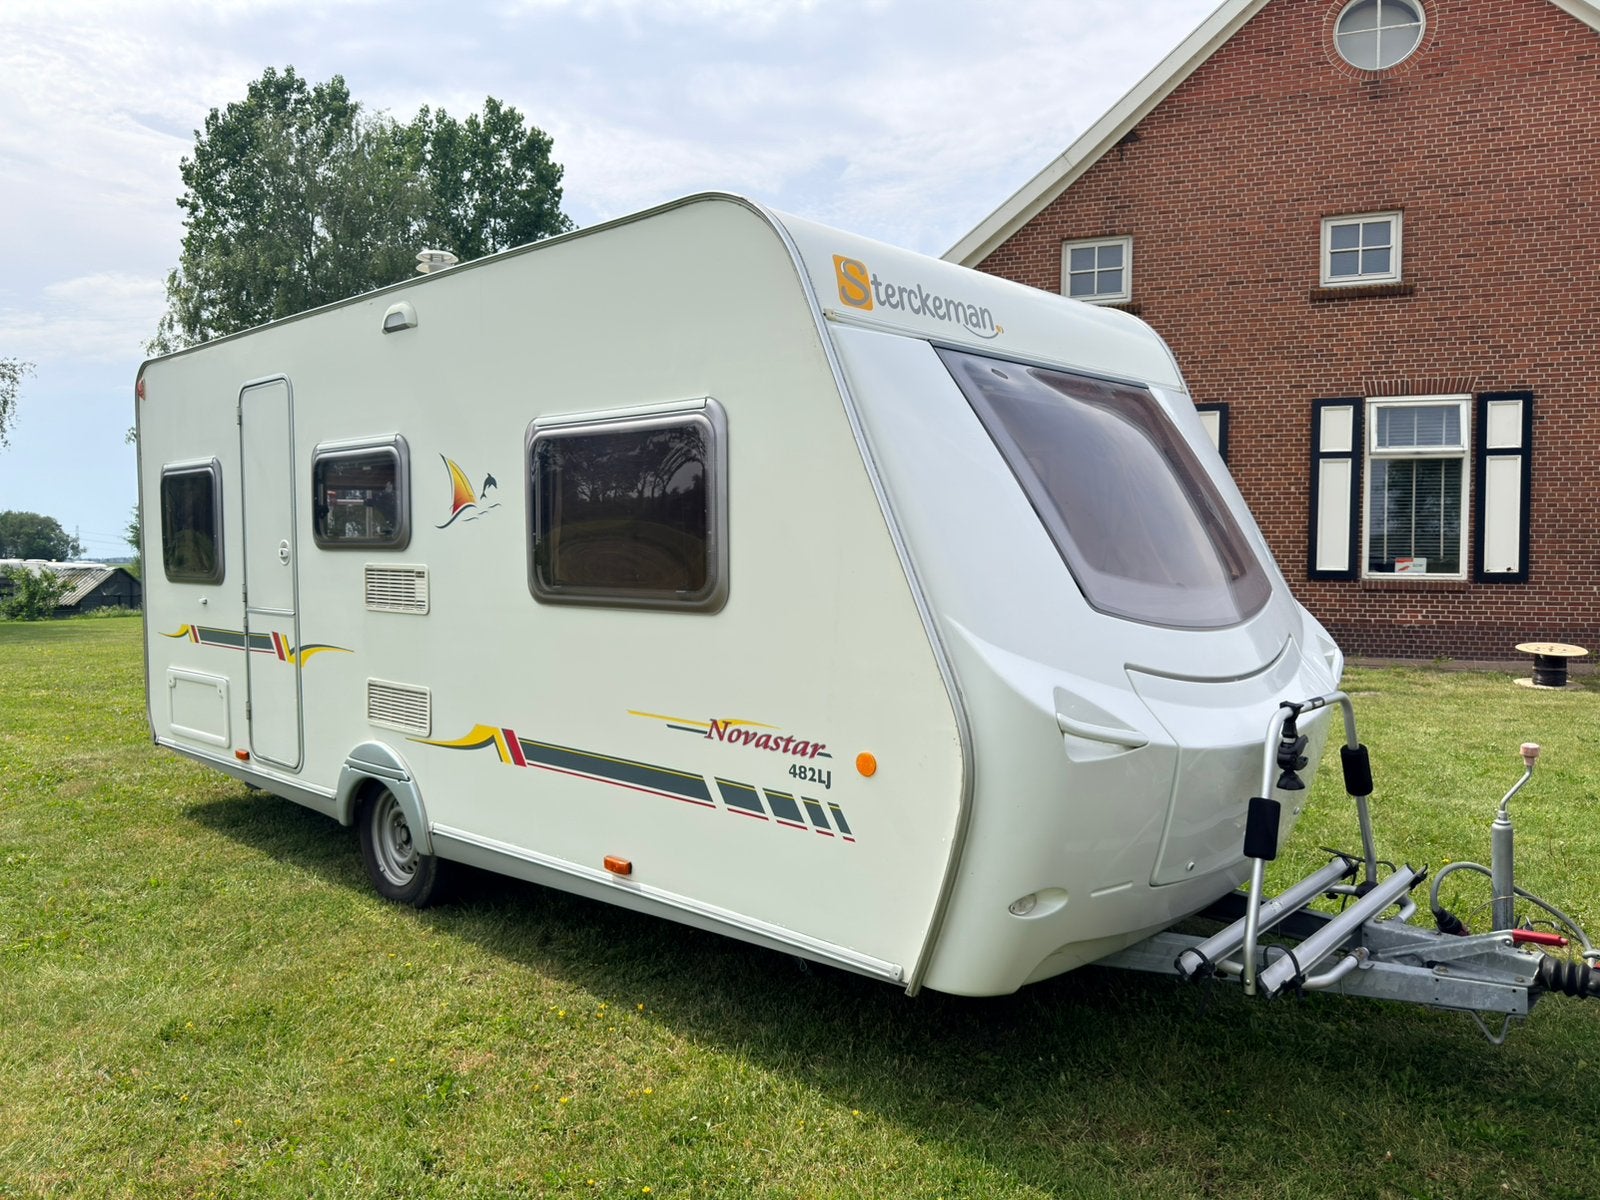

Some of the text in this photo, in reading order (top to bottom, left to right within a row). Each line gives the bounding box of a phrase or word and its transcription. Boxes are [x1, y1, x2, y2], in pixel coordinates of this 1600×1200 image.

[839, 258, 995, 331] Sterckeman
[704, 718, 826, 759] Novastar
[788, 763, 832, 790] 482LJ
